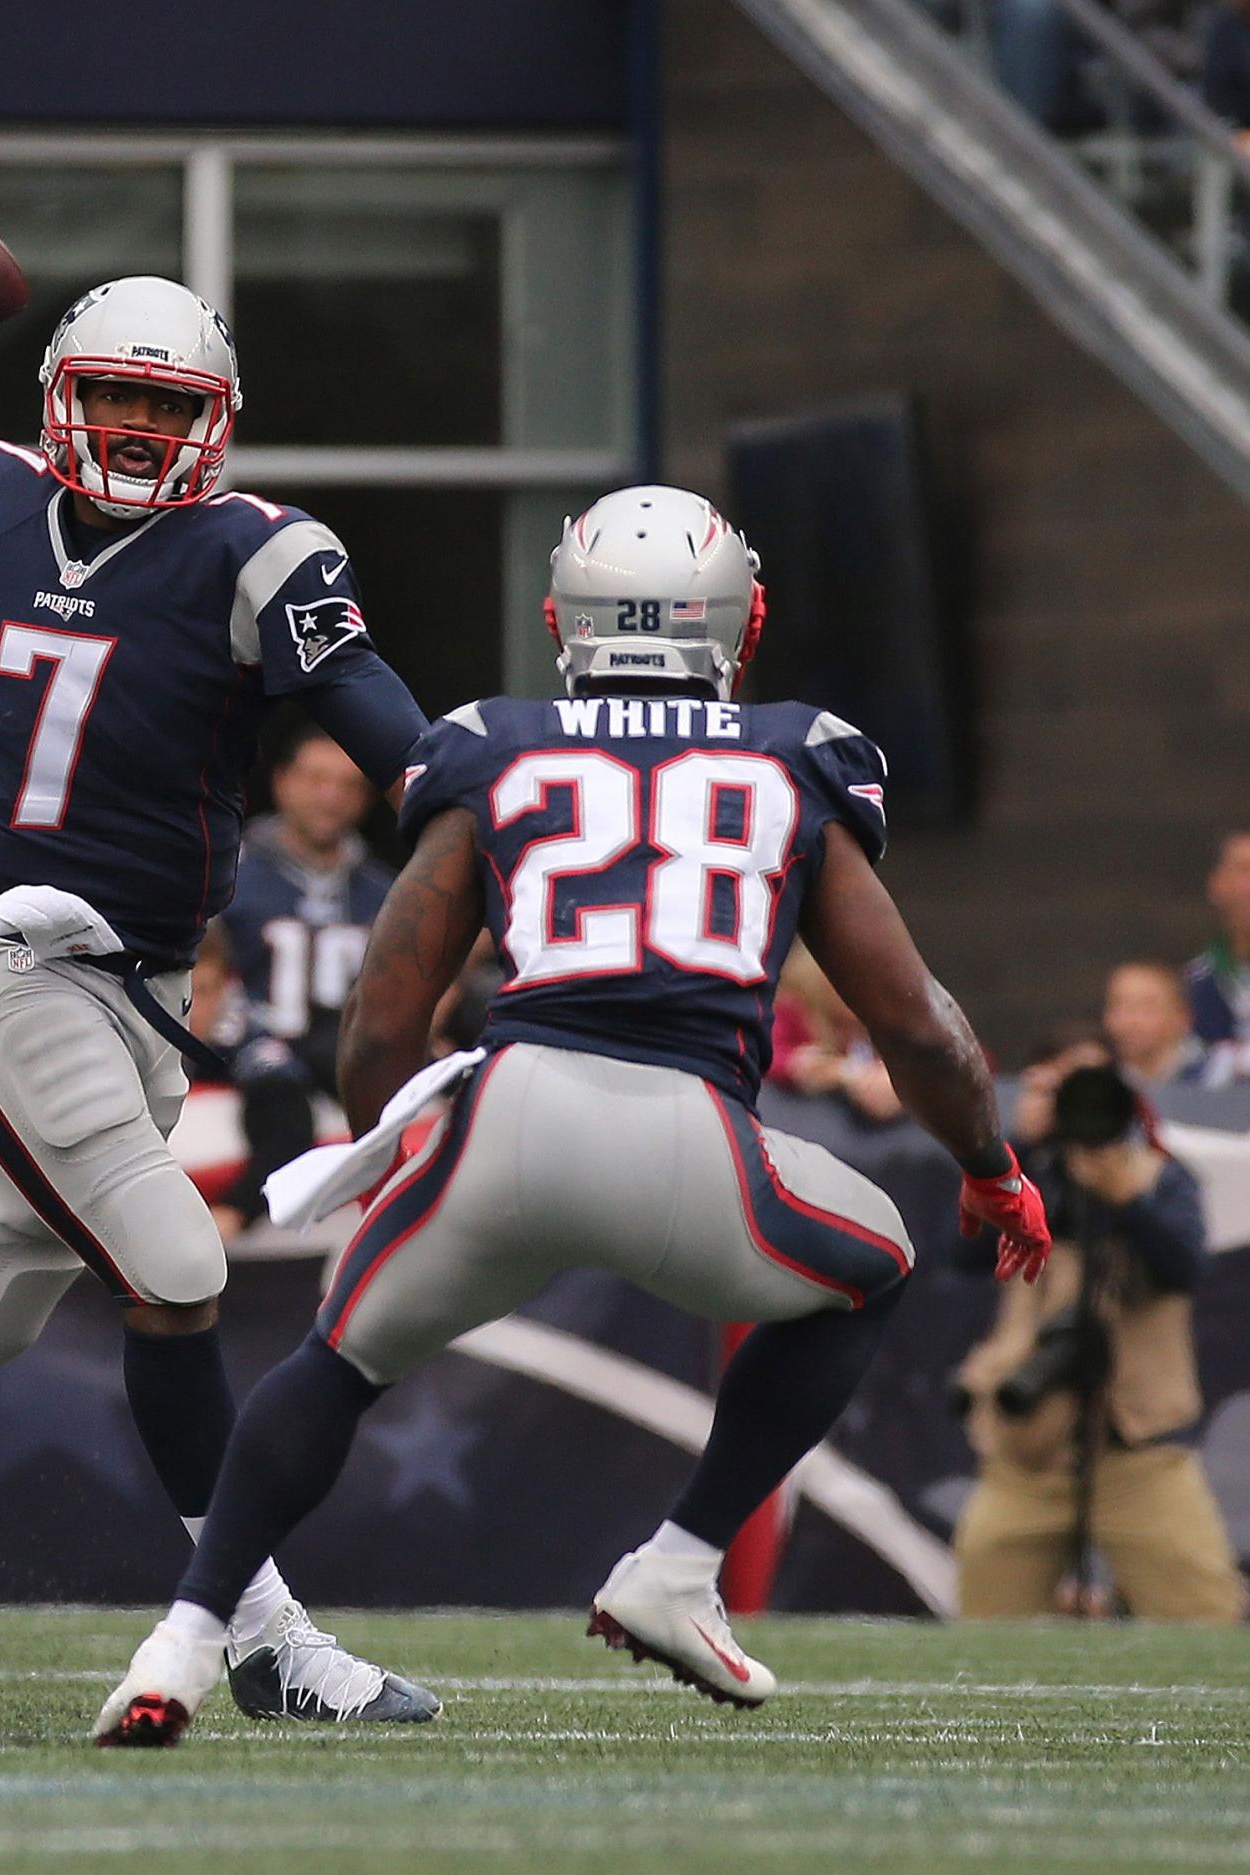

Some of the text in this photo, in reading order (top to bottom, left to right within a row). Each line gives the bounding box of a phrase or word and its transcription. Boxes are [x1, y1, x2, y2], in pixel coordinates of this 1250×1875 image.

[34, 591, 96, 618] PATRIOTS
[617, 599, 661, 632] 28
[610, 653, 666, 668] PATRIOTS
[553, 698, 743, 739] WHITE
[489, 747, 801, 993] 28
[11, 958, 32, 969] NFL
